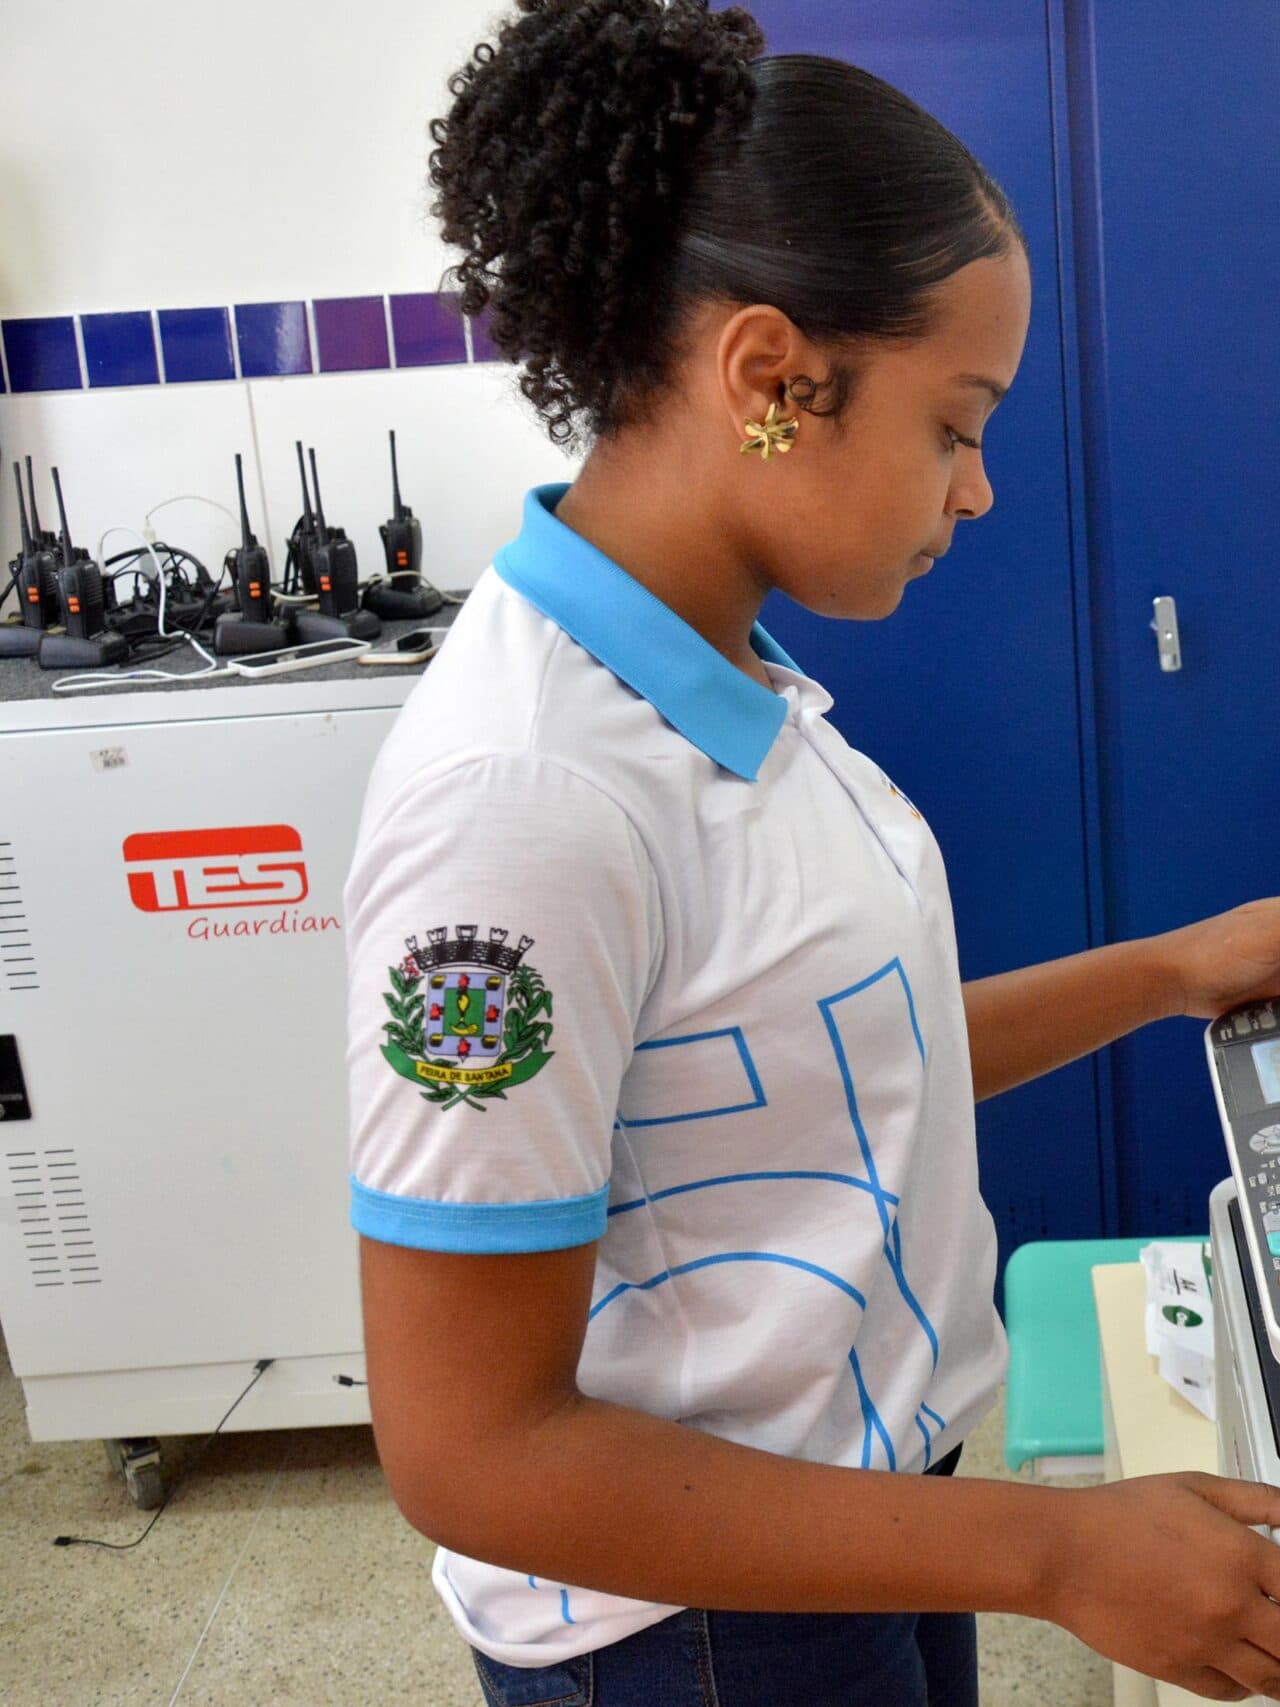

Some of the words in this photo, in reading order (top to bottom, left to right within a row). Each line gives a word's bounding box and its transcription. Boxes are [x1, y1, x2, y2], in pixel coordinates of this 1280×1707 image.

[123, 848, 307, 909] TES
[187, 909, 341, 941] Guardian
[449, 1071, 461, 1080] DE
